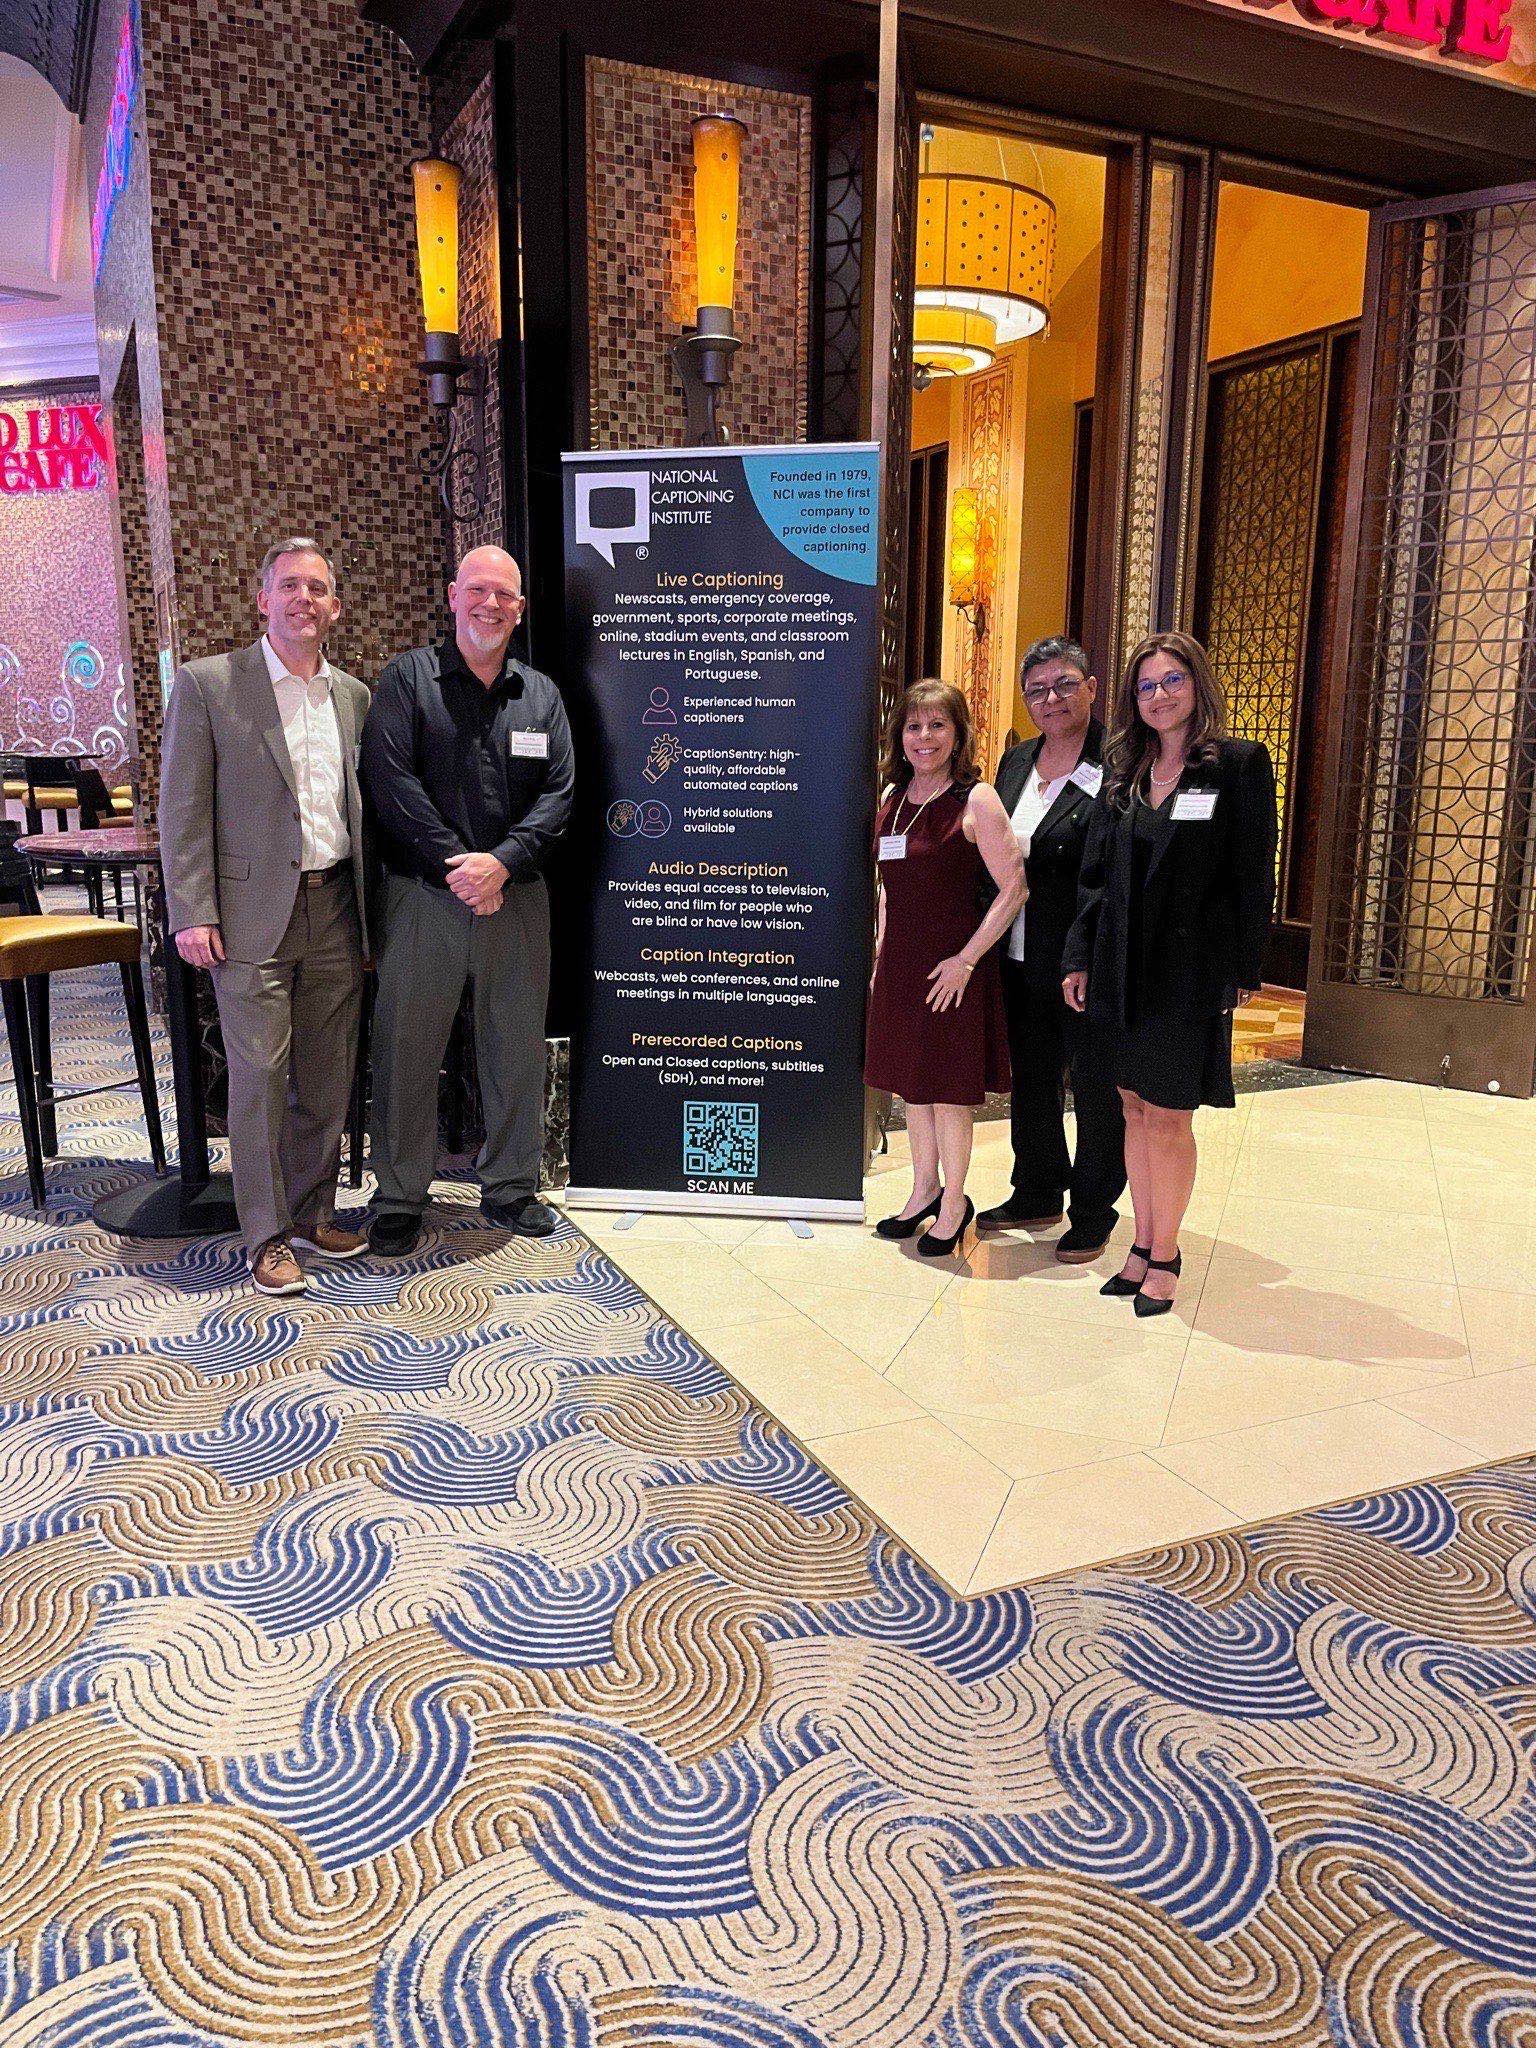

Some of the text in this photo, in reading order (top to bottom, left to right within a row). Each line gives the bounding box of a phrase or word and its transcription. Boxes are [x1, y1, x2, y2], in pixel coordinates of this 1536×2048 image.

[26, 403, 107, 461] LUX
[0, 447, 98, 491] CAFE
[771, 469, 872, 483] Founded in 1979,
[652, 470, 718, 484] NATIONAL
[652, 490, 734, 504] CAPTIONING
[773, 486, 871, 501] NCI was the first
[652, 511, 711, 524] INSTITUTE
[801, 506, 871, 518] company to
[783, 523, 869, 537] provide closed
[804, 540, 869, 554] captioning.
[658, 571, 783, 590] Live Captioning
[615, 594, 833, 607] Newscasts, emergency coverage,
[593, 610, 857, 626] government, sports, corporate meetings,
[600, 630, 849, 643] online, stadium events, and classroom
[620, 649, 824, 663] lectures in English, Spanish, and
[686, 668, 761, 682] Portuguese.
[684, 696, 795, 709] Experienced human
[684, 712, 744, 725] captioners
[684, 749, 800, 762] CaptionSentry: high-
[684, 764, 786, 777] quality, affordable
[684, 781, 798, 793] automated captions
[684, 807, 772, 819] Hybrid solutions
[684, 823, 735, 833] available
[649, 861, 788, 880] Audio Description
[609, 881, 829, 898] Provides equal access to television,
[625, 898, 812, 915] video, and film for people who
[632, 916, 804, 930] are blind or have low vision.
[641, 948, 794, 967] Caption Integration
[594, 971, 839, 987] Webcasts, web conferences, and online
[617, 988, 816, 1006] meetings in multiple languages.
[633, 1033, 802, 1052] Prerecorded Captions
[602, 1055, 824, 1072] Open and Closed captions, subtitles
[659, 1070, 764, 1086] (SDH), and more!
[687, 1179, 755, 1195] SCAN ME
